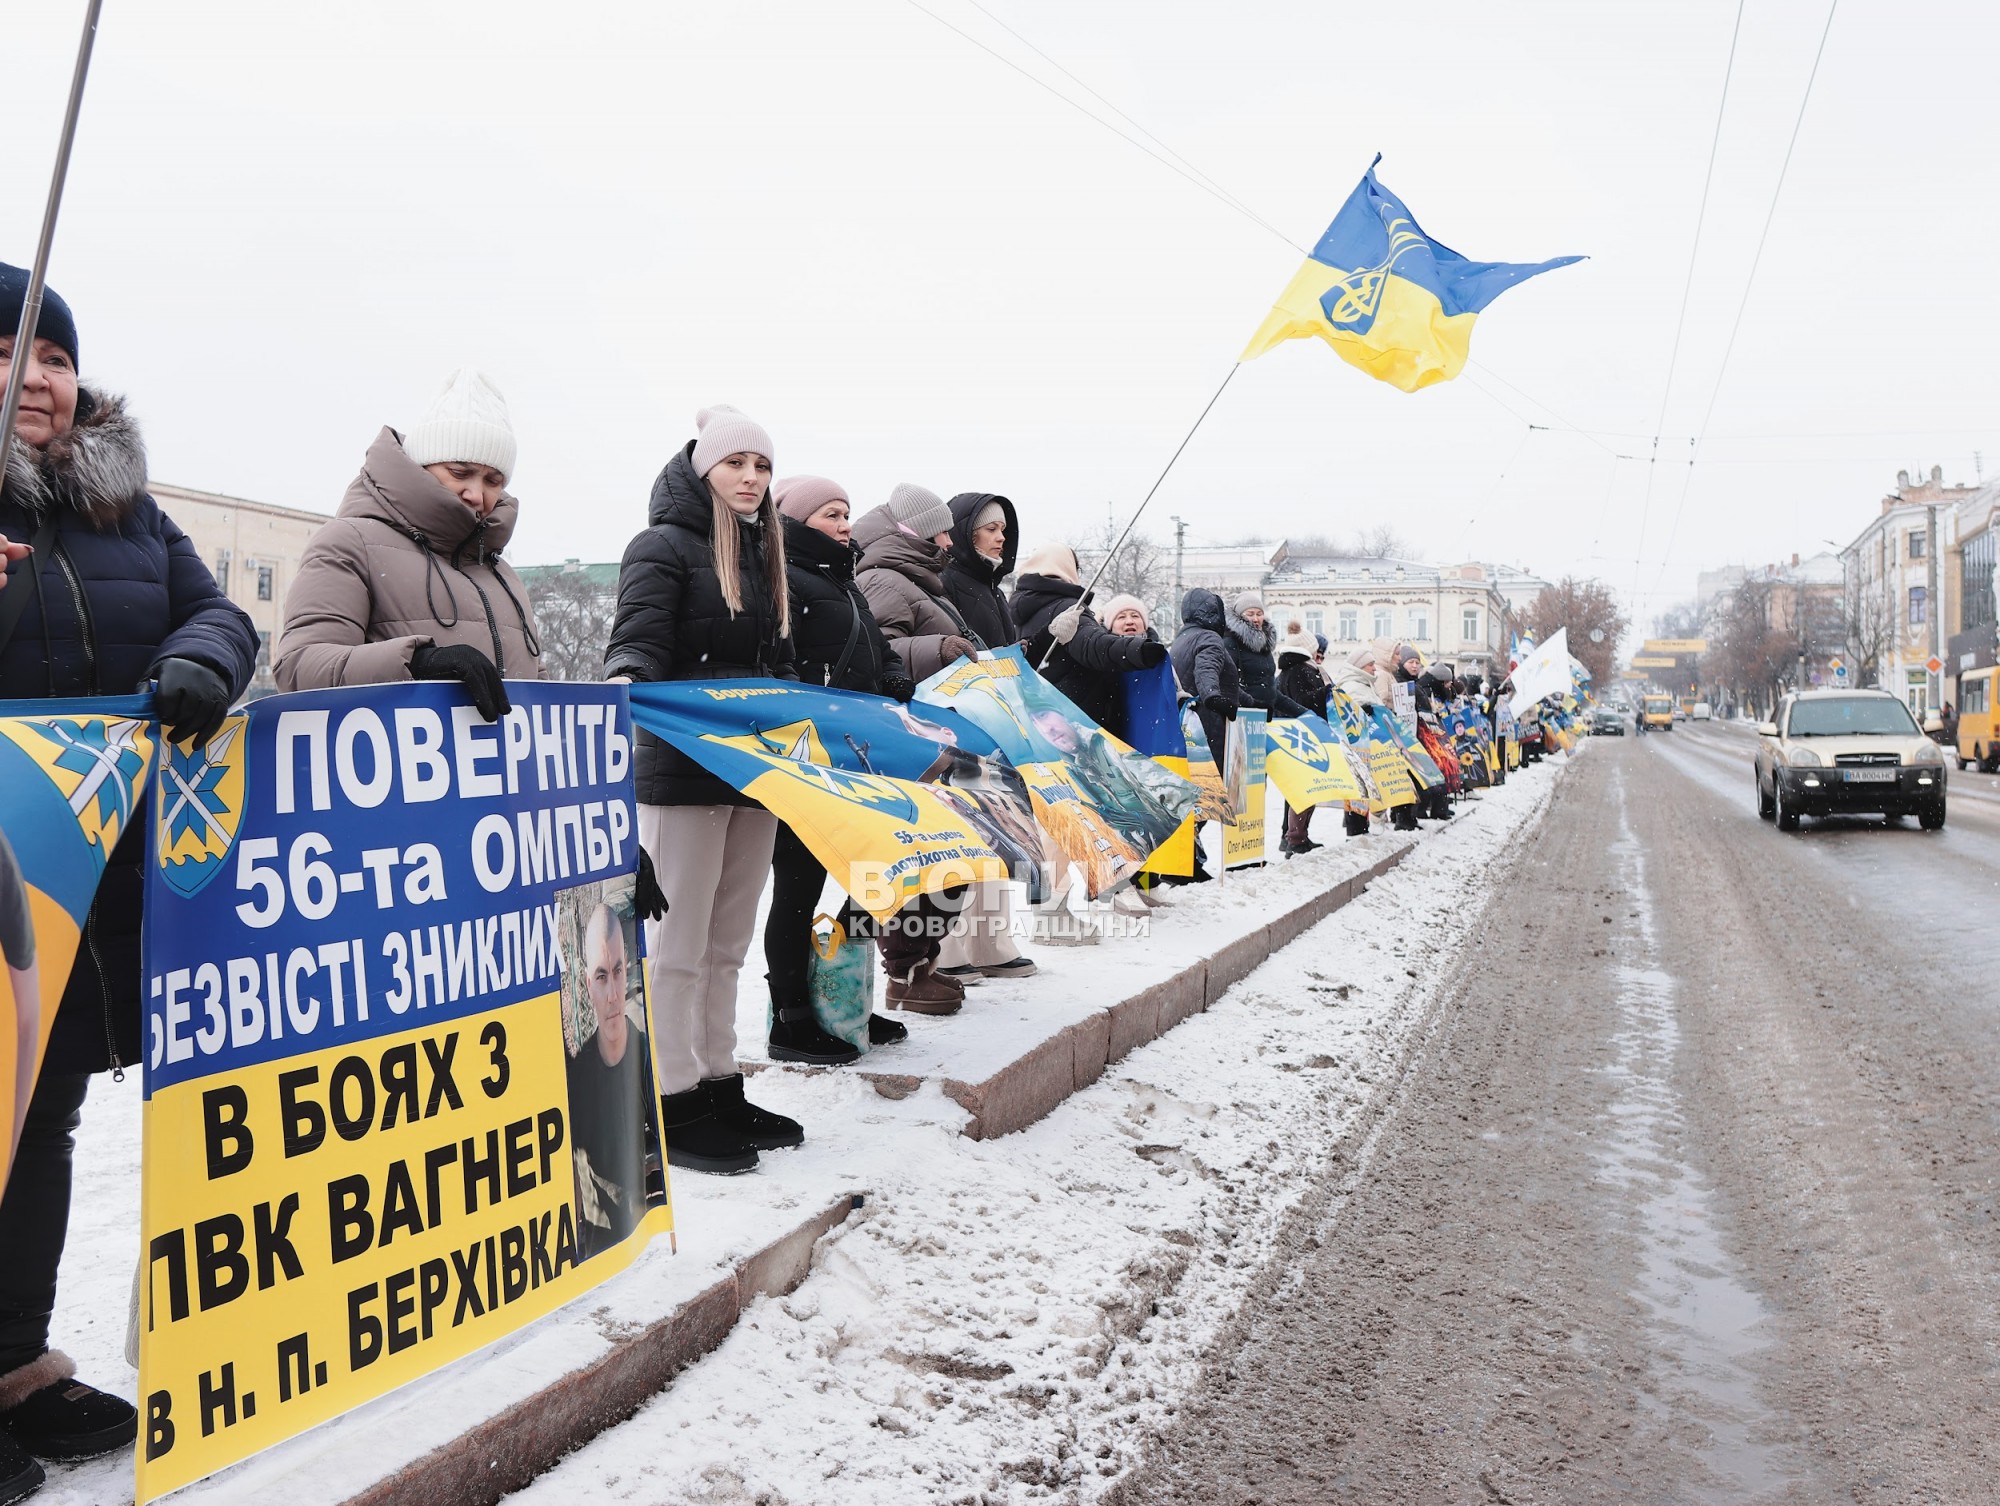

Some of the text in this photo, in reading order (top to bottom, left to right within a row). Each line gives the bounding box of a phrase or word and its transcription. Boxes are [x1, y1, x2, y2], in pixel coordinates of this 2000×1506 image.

[275, 704, 629, 815] ПОВЕРНІТЬ
[236, 799, 629, 929] 56-та ОМПБР
[383, 902, 567, 1015] ЗНИКЛИХ
[202, 1085, 253, 1181] В
[278, 1031, 464, 1159] БОЯХ
[149, 1107, 564, 1333] ПВК ВАГНЕР
[348, 1202, 579, 1372] БЕРХІВКА
